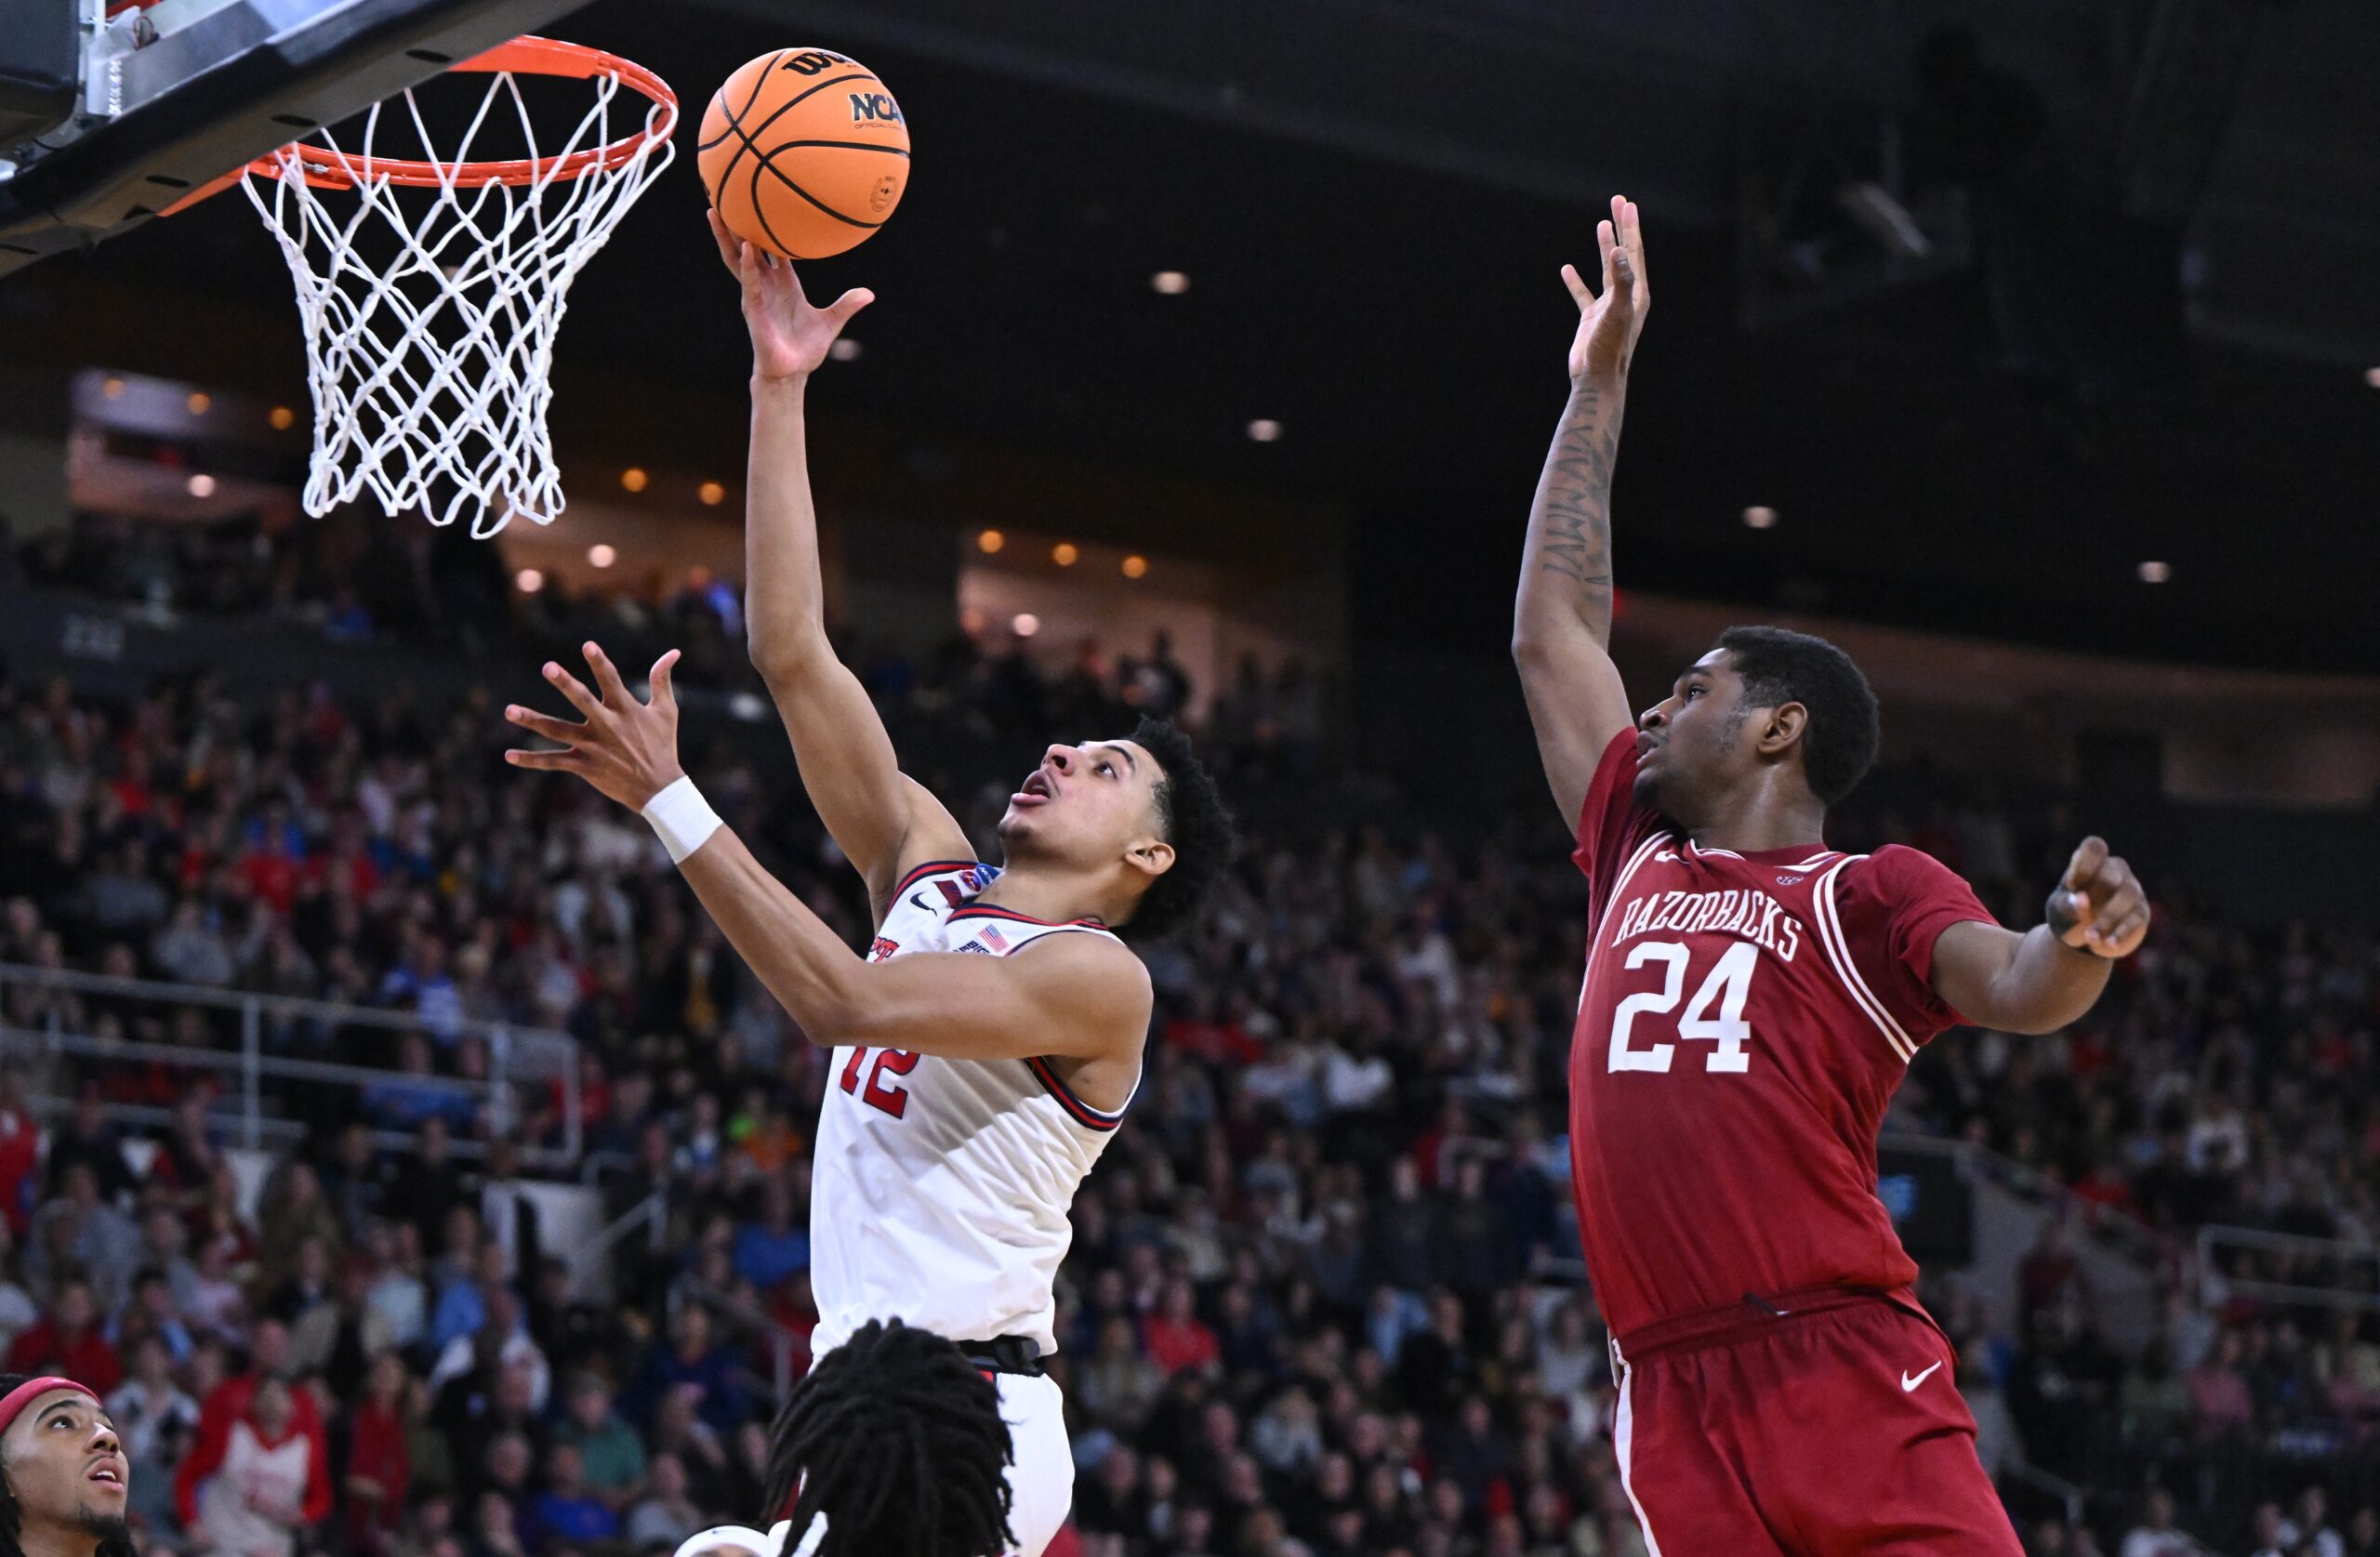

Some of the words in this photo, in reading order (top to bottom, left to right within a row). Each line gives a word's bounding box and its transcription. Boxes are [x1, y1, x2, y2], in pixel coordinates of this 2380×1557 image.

[1611, 889, 1802, 962] RAZORBACKS
[1607, 941, 1759, 1074] 24
[840, 1046, 921, 1120] 12
